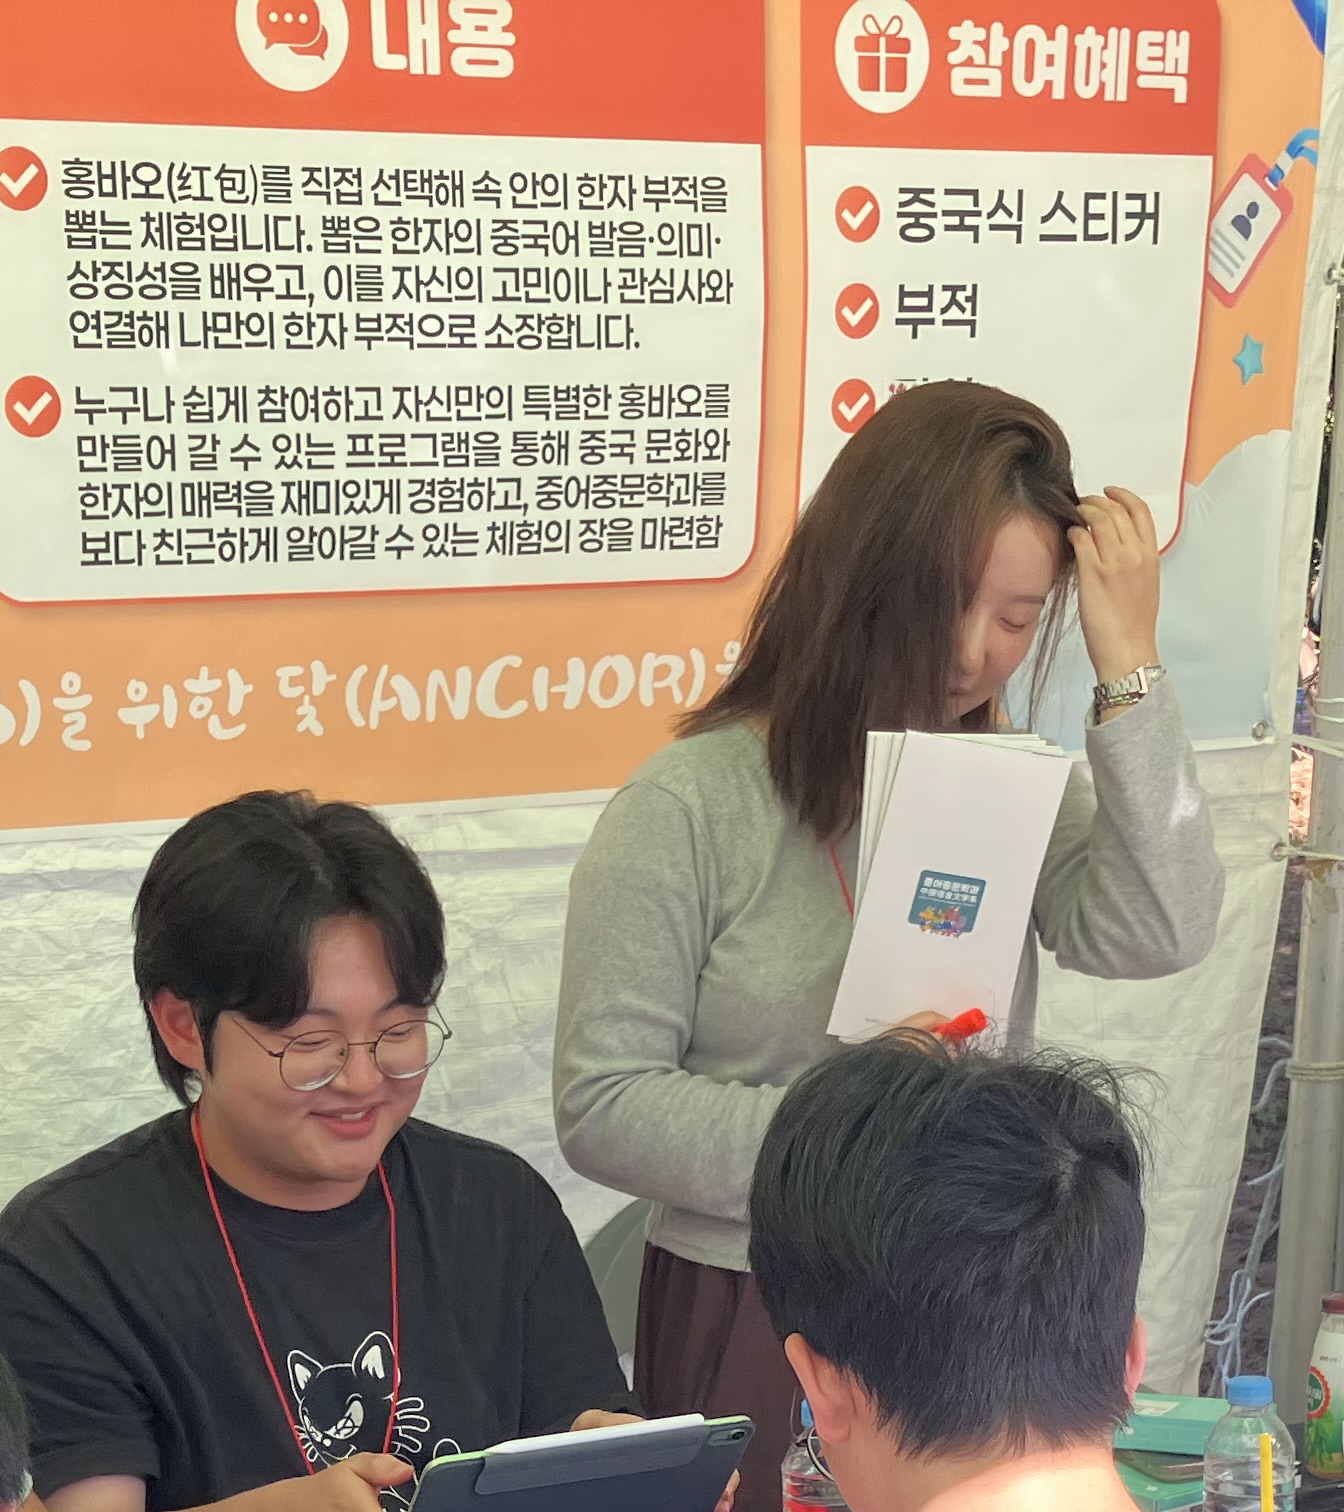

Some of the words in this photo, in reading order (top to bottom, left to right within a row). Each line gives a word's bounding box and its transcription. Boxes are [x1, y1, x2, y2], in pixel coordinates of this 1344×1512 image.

[370, 0, 516, 78] 내용
[947, 20, 1190, 103] 참여혜택
[61, 157, 293, 206] 홍바오(红包)를
[301, 166, 363, 206] 직접
[371, 168, 464, 208] 선택해
[472, 170, 502, 209] 속
[509, 172, 568, 210] 안의
[576, 173, 637, 211] 한자
[643, 175, 728, 213] 부적을
[64, 209, 133, 250] 뽑는
[140, 211, 313, 253] 체험입니다.
[320, 215, 383, 254] 뽑은
[389, 216, 482, 256] 한자의
[490, 219, 580, 257] 중국어
[896, 187, 1024, 244] 중국식
[1039, 190, 1160, 245] 스티커
[67, 260, 202, 301] 상징성을
[209, 262, 315, 308] 배우고,
[324, 264, 384, 302] 이를
[392, 265, 483, 303] 자신의
[492, 266, 612, 304] 고민이나
[617, 267, 734, 305] 관심사와
[69, 310, 170, 349] 연결해
[179, 311, 275, 350] 나만의
[282, 311, 348, 350] 한자
[354, 313, 477, 351] 부적으로
[484, 312, 640, 350] 소장합니다.
[895, 283, 978, 340] 부적
[74, 385, 176, 426] 누구나
[182, 385, 248, 424] 쉽게
[257, 385, 384, 423] 참여하고
[392, 384, 513, 422] 자신만의
[522, 384, 612, 421] 특별한
[618, 383, 731, 420] 홍바오를
[77, 433, 176, 473] 만들어
[187, 433, 221, 471] 갈
[230, 433, 262, 472] 수
[272, 433, 336, 470] 있는
[345, 431, 501, 468] 프로그램을
[511, 430, 569, 467] 통해
[579, 429, 636, 465] 중국
[645, 427, 731, 464] 문화와
[78, 481, 173, 521] 한자의
[180, 480, 275, 518] 매력을
[281, 478, 401, 517] 재미있게
[408, 477, 529, 516] 경험하고,
[535, 472, 726, 511] 중어중문학과를
[80, 529, 147, 567] 보다
[153, 526, 278, 566] 친근하게
[286, 524, 380, 563] 알아갈
[384, 524, 415, 560] 수
[422, 522, 479, 558] 있는
[485, 519, 571, 556] 체험의
[578, 517, 634, 553] 장을
[641, 514, 723, 551] 마련함
[118, 666, 253, 740] 위한
